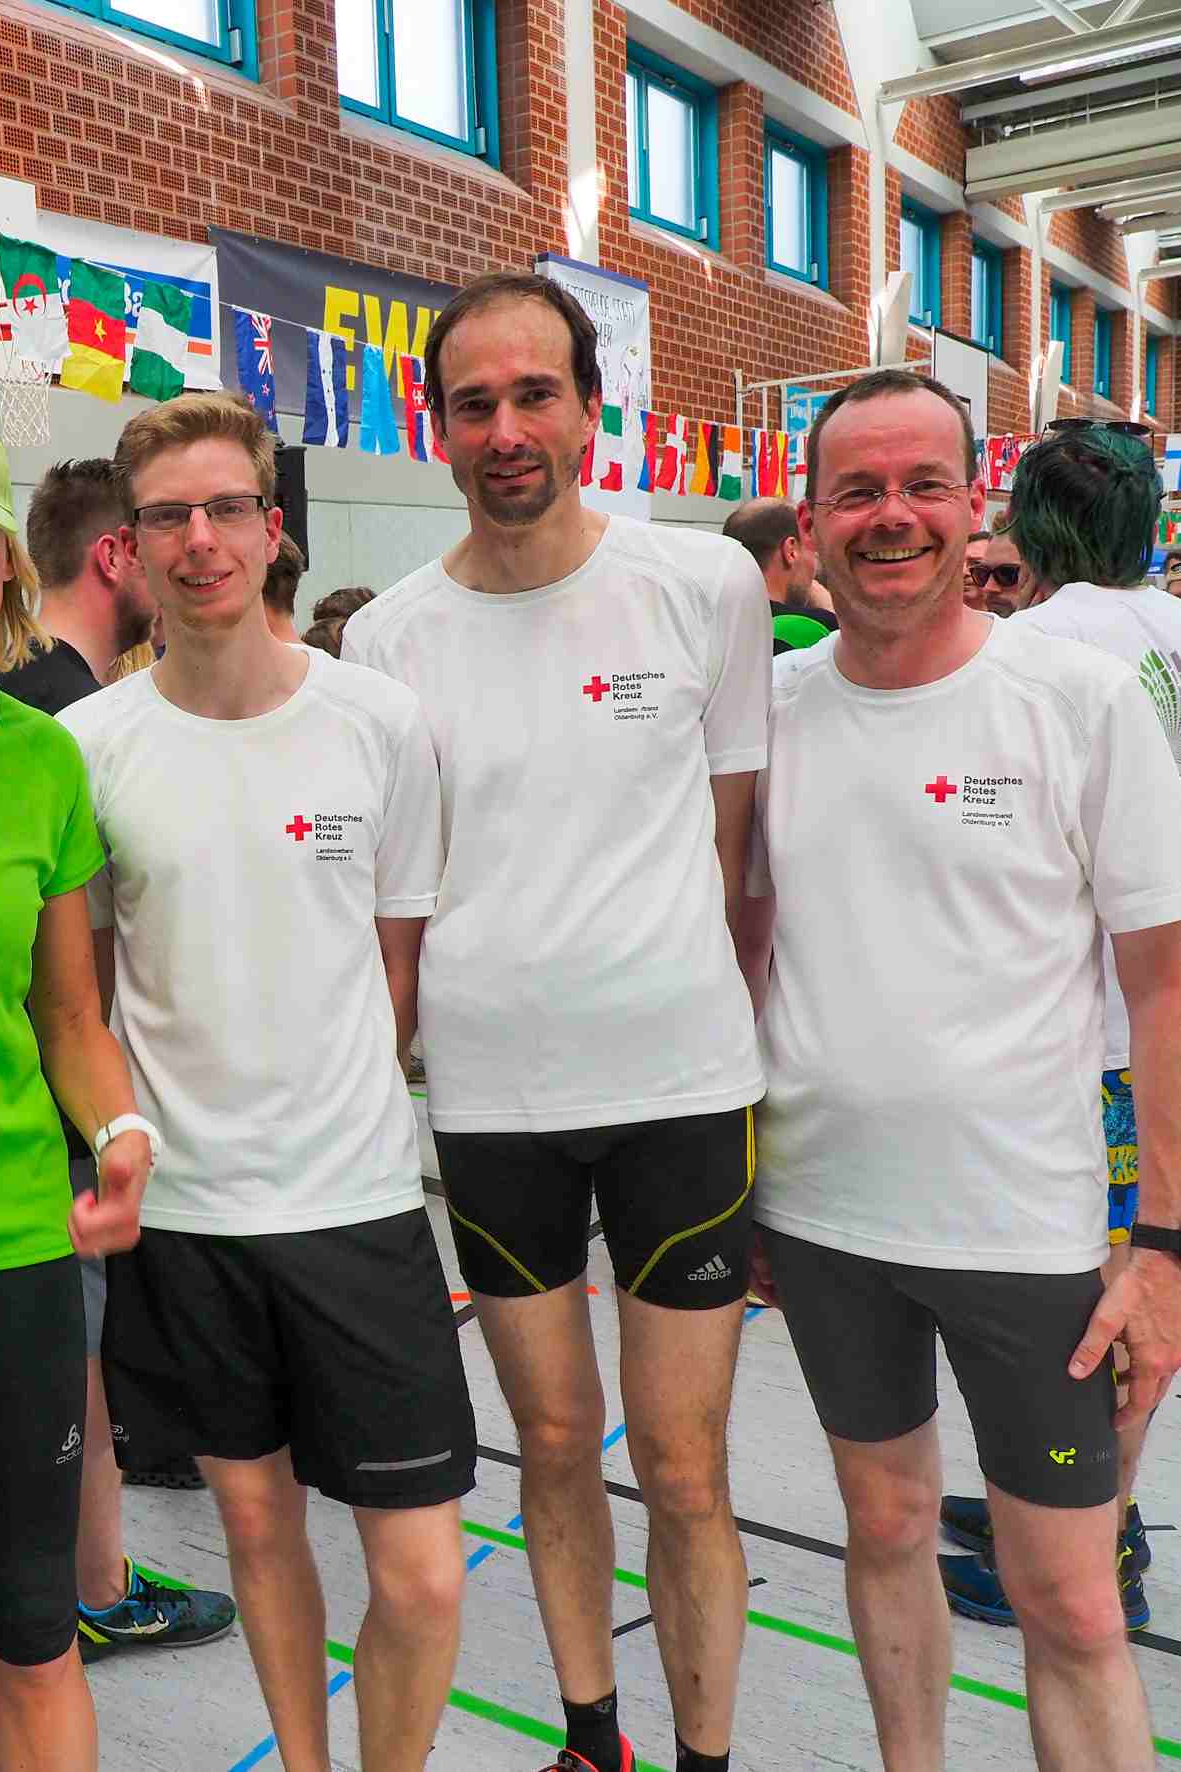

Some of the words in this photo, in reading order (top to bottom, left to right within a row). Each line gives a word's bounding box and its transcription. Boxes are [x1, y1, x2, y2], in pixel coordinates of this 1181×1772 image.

[323, 285, 443, 400] EW
[612, 671, 665, 682] Deutsches
[612, 683, 642, 691] Rotes
[612, 692, 643, 701] Kreuz
[964, 776, 1023, 786] Deutsches
[963, 785, 997, 795] Rotes
[963, 795, 996, 805] Kreuz
[314, 814, 363, 823] Deutsches
[315, 823, 343, 831] Rotes
[315, 833, 343, 841] Kreuz
[687, 1267, 731, 1281] adidas
